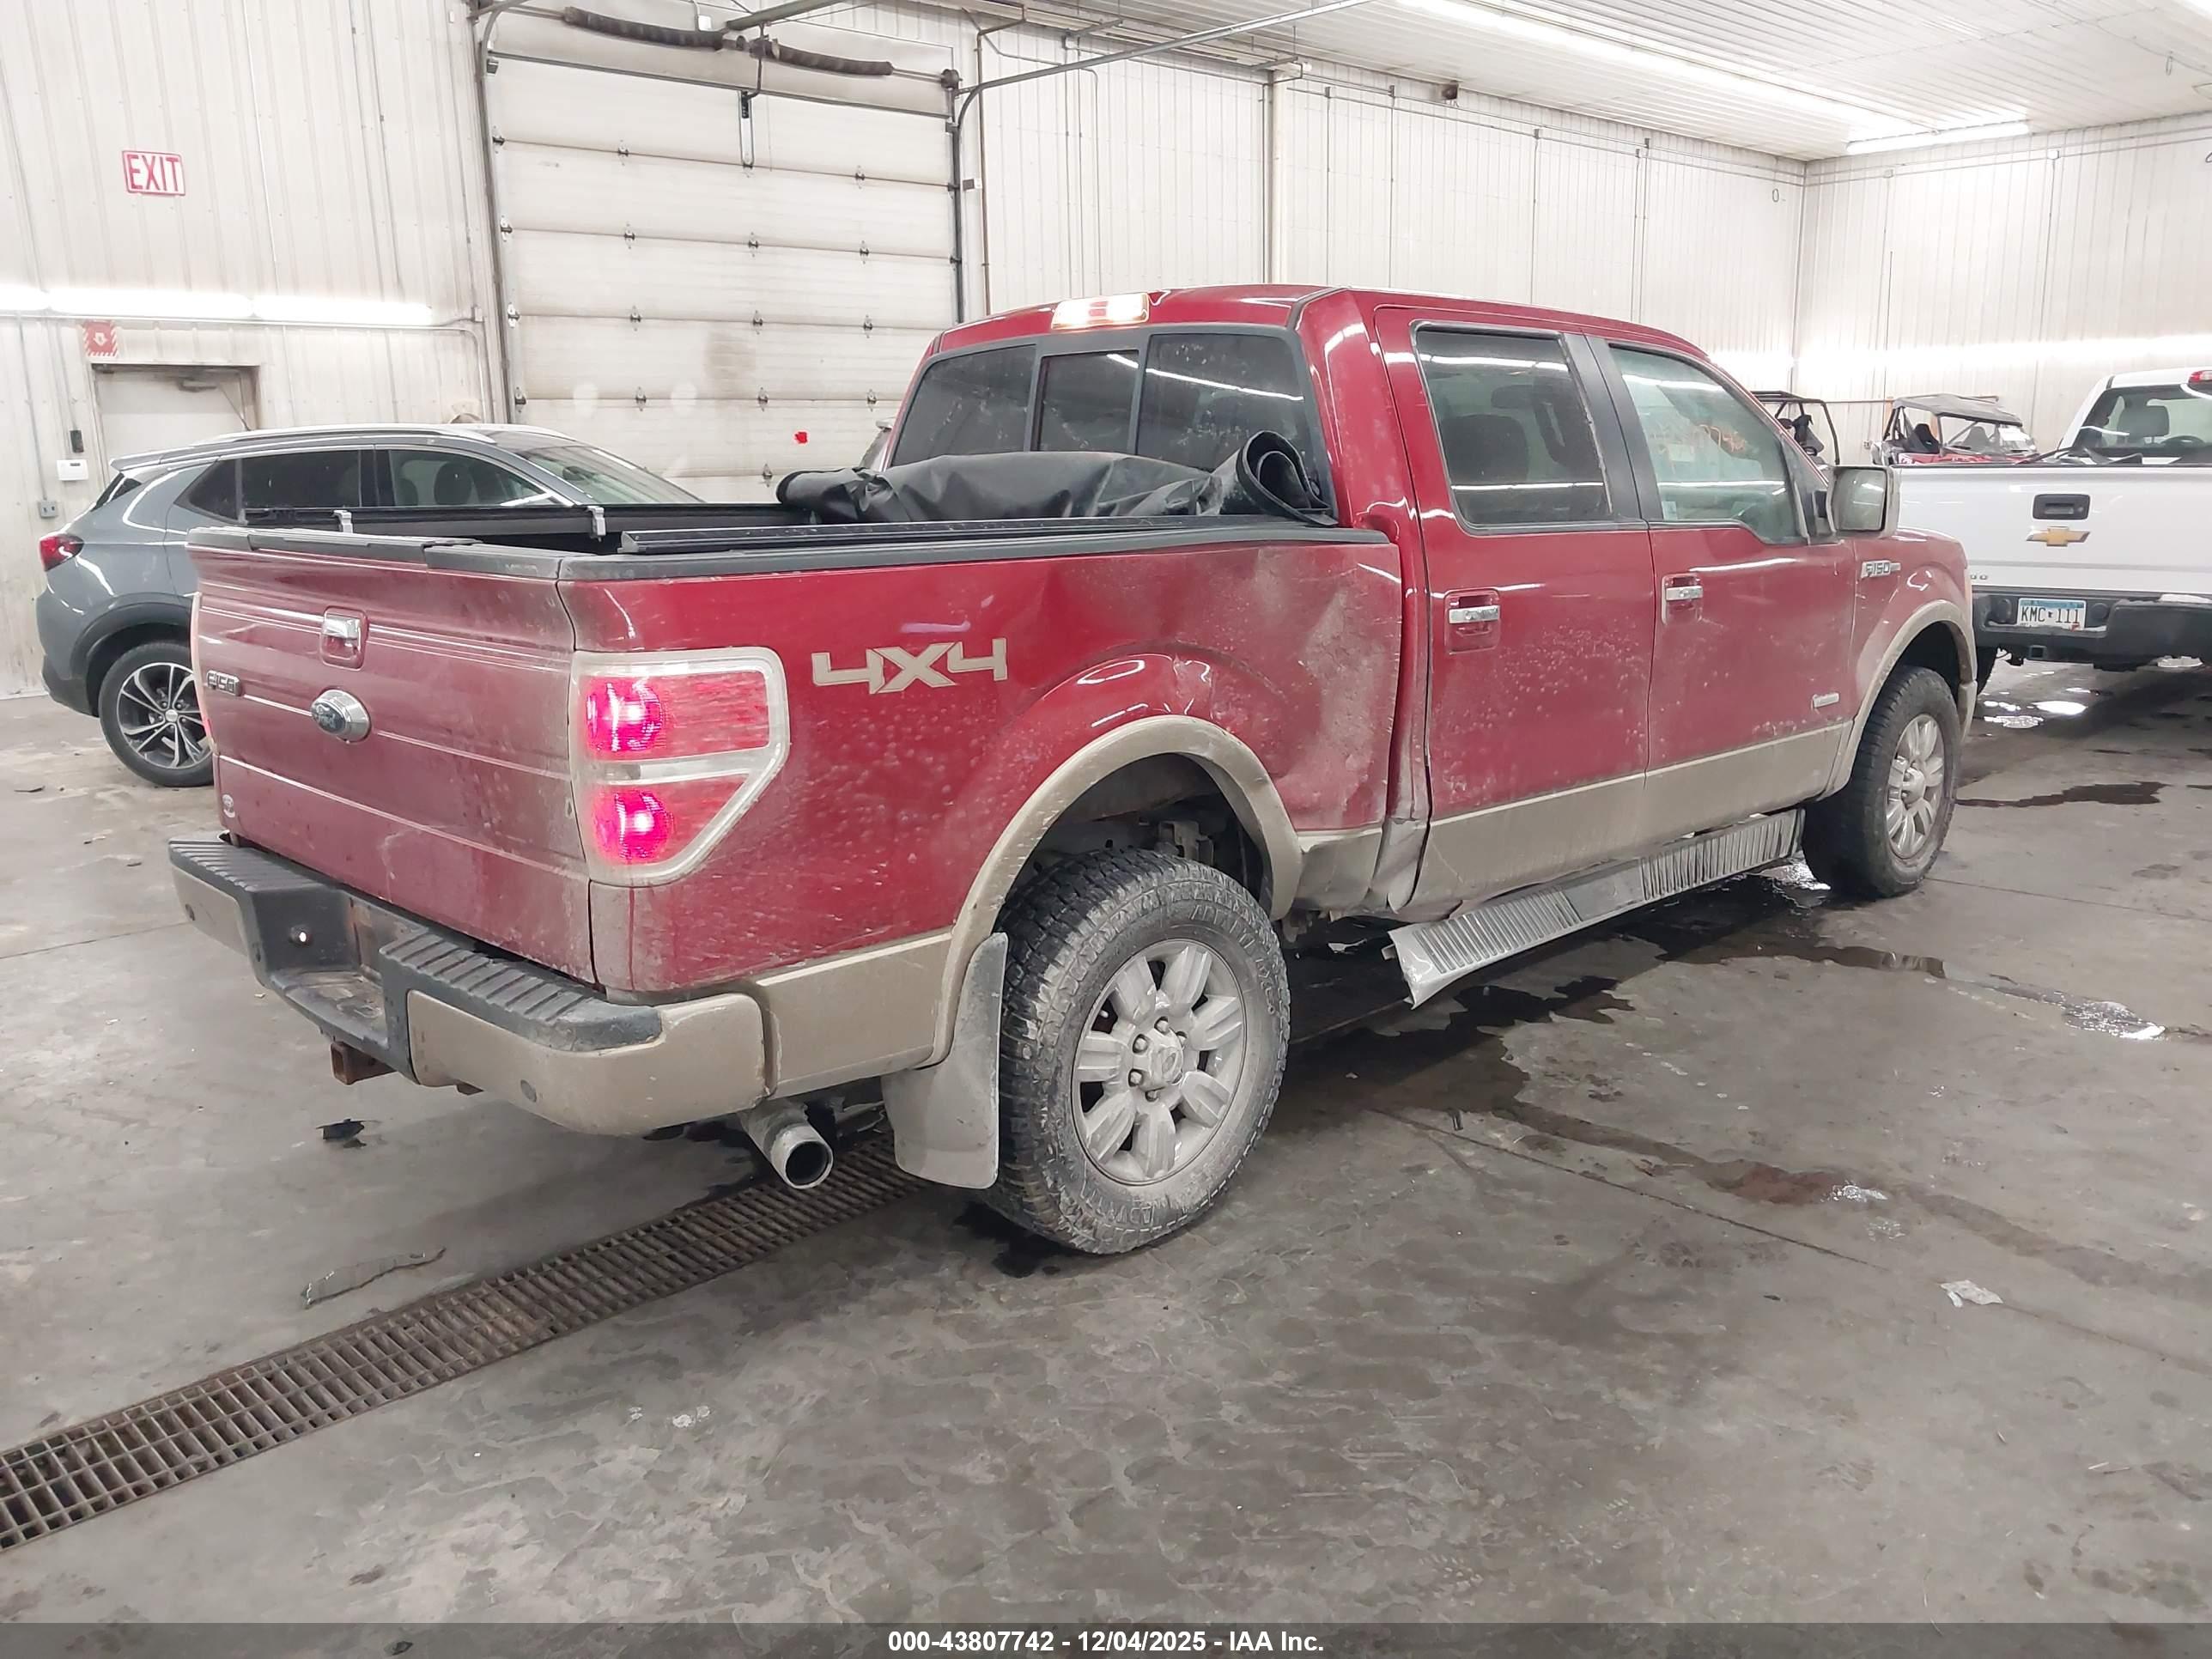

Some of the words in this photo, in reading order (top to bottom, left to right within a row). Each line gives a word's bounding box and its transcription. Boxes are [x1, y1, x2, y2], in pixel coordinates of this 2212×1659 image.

[127, 155, 179, 191] EXIT
[2021, 606, 2045, 623] KMC
[2056, 608, 2080, 623] 111
[811, 637, 1008, 695] 4X4
